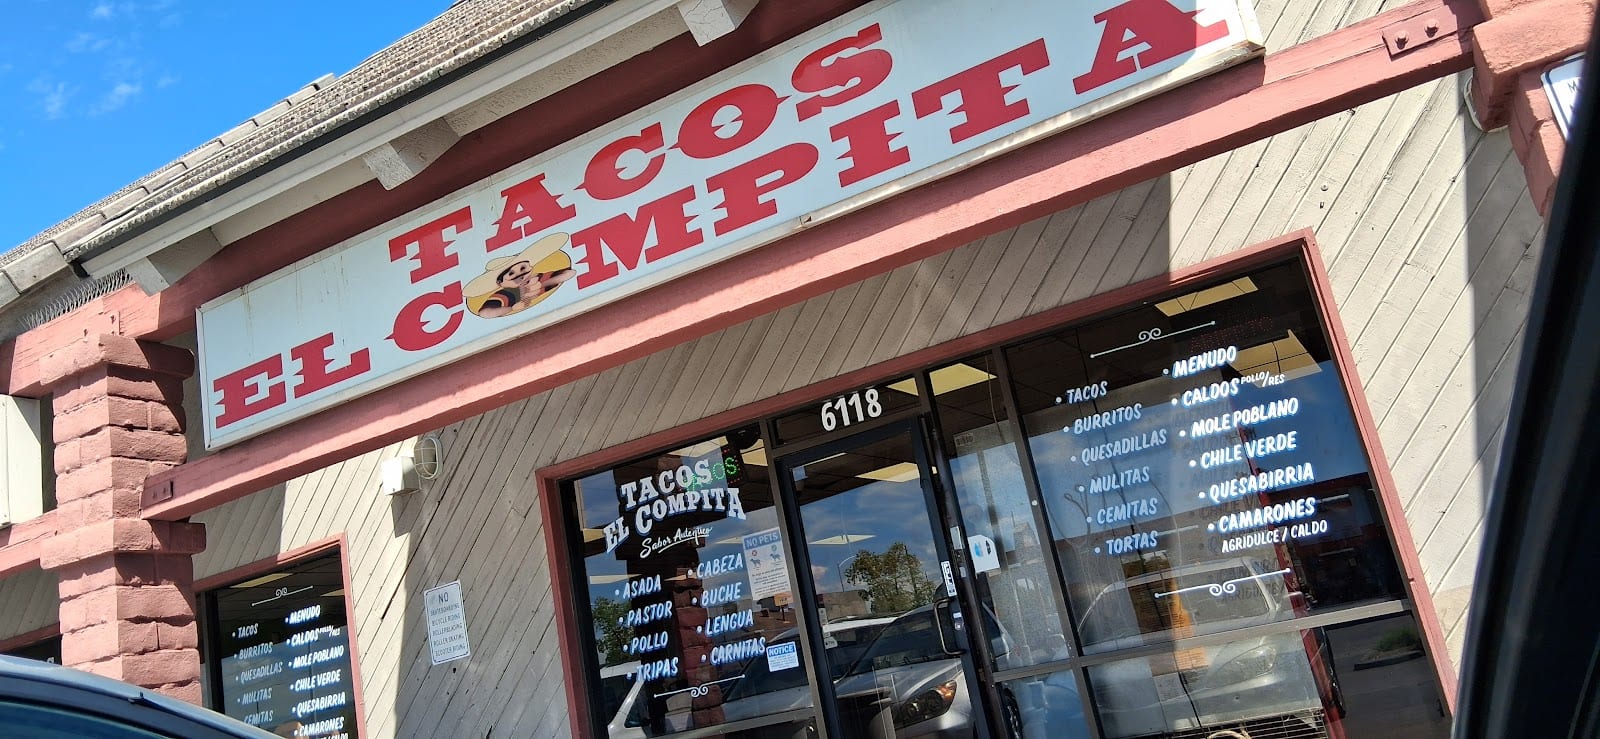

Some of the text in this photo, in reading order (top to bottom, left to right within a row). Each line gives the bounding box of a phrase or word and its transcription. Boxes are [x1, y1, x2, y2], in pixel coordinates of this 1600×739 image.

[389, 22, 893, 284] TACOS
[1172, 346, 1237, 378] MENUDO
[213, 332, 371, 429] EL
[1067, 380, 1108, 404] TACOS
[1182, 378, 1240, 407] CALDOS
[821, 388, 883, 431] 6118
[1074, 403, 1142, 434] BURRITOS
[1191, 397, 1299, 438] MOLE POBLANO
[1081, 429, 1167, 466] QUESADILLAS
[1201, 431, 1297, 469] CHILE VERDE
[621, 458, 713, 510] TACOS
[1089, 466, 1150, 495] MULITAS
[1209, 462, 1314, 504] QUESABIRRIA
[602, 488, 746, 553] EL COMPITA
[1097, 497, 1158, 525] CEMITAS
[1218, 497, 1316, 533] CAMARONES
[640, 537, 672, 558] Sabor
[745, 532, 779, 548] NO PETS
[1105, 530, 1158, 555] TORTAS
[1221, 529, 1280, 553] AGRIDULCE
[1290, 519, 1328, 540] CALDO
[696, 553, 744, 579] CABEZA
[438, 592, 449, 604] NO
[622, 574, 662, 599] ASADA
[701, 582, 742, 607] BUCHE
[289, 604, 321, 624] MENUDO
[626, 600, 673, 627] PASTOR
[705, 609, 754, 637] LENGUA
[237, 623, 259, 639] TACOS
[291, 628, 319, 647] CALDOS
[630, 630, 669, 655] POLLO
[238, 642, 273, 660] BURRITOS
[293, 645, 344, 669] MOLE POBLANO
[710, 636, 767, 666] CARNITAS
[769, 644, 794, 656] NOTICE
[240, 662, 283, 684] QUESADILLAS
[295, 669, 341, 692] CHILE VERDE
[635, 657, 679, 684] TRIPAS
[242, 687, 273, 705] MULITAS
[297, 691, 346, 718] QUESABIRRIA
[299, 716, 345, 737] CAMARONES
